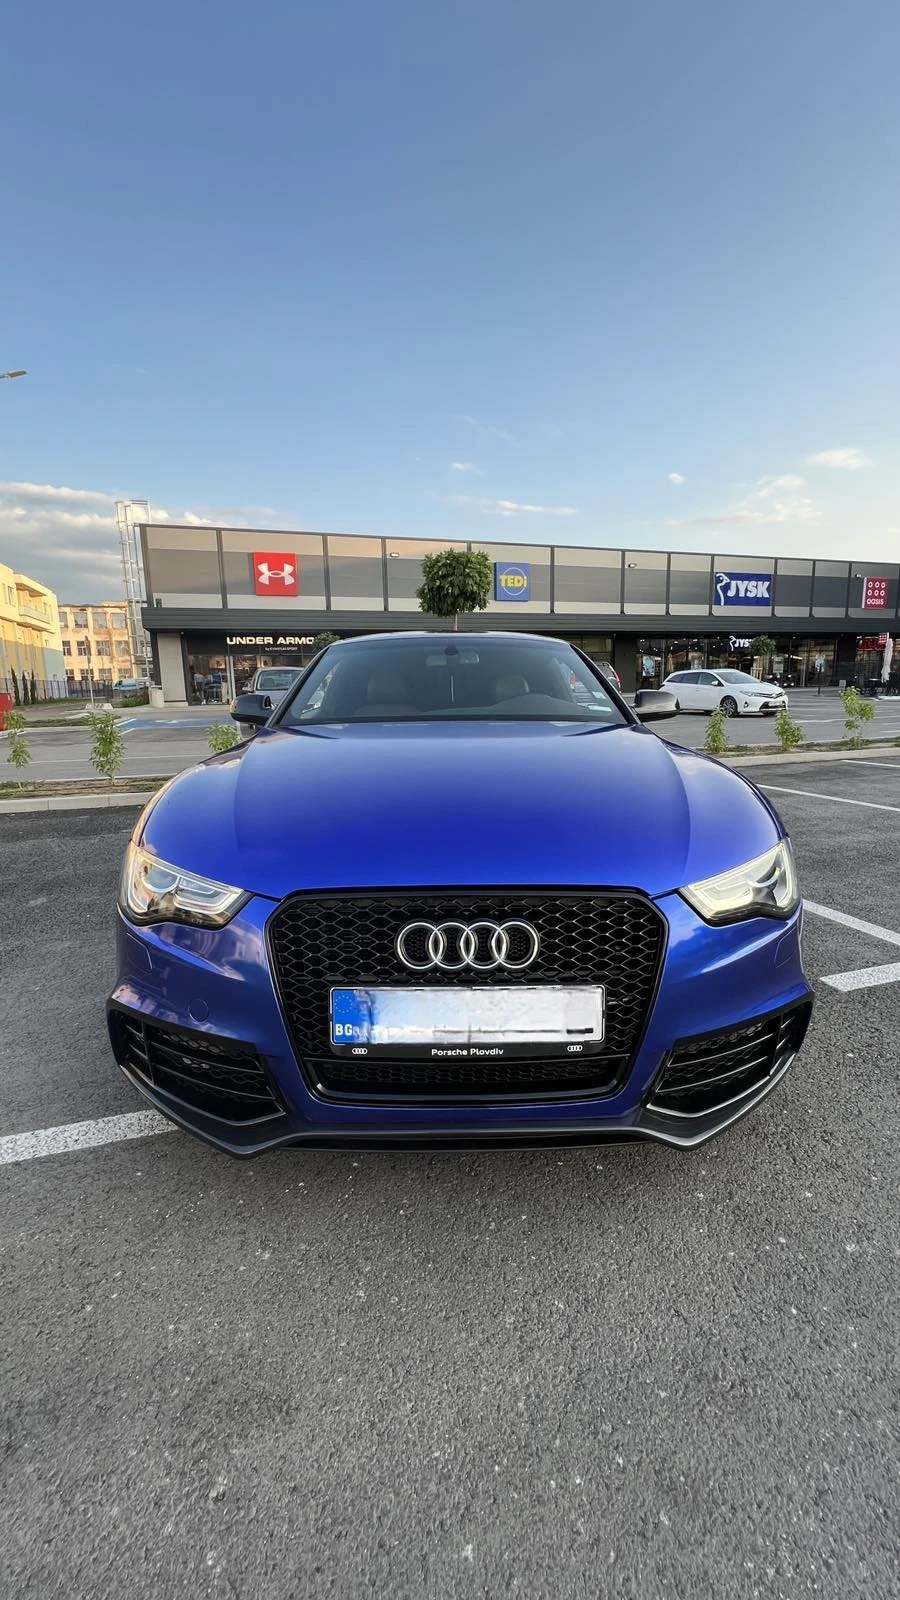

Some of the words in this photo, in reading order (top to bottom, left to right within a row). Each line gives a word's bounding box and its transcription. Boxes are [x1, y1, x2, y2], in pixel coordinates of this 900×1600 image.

[500, 575, 527, 587] TEDi
[727, 581, 770, 598] JYSK
[226, 636, 274, 645] UNDER
[335, 1023, 353, 1036] BG
[431, 1048, 468, 1056] Porsche
